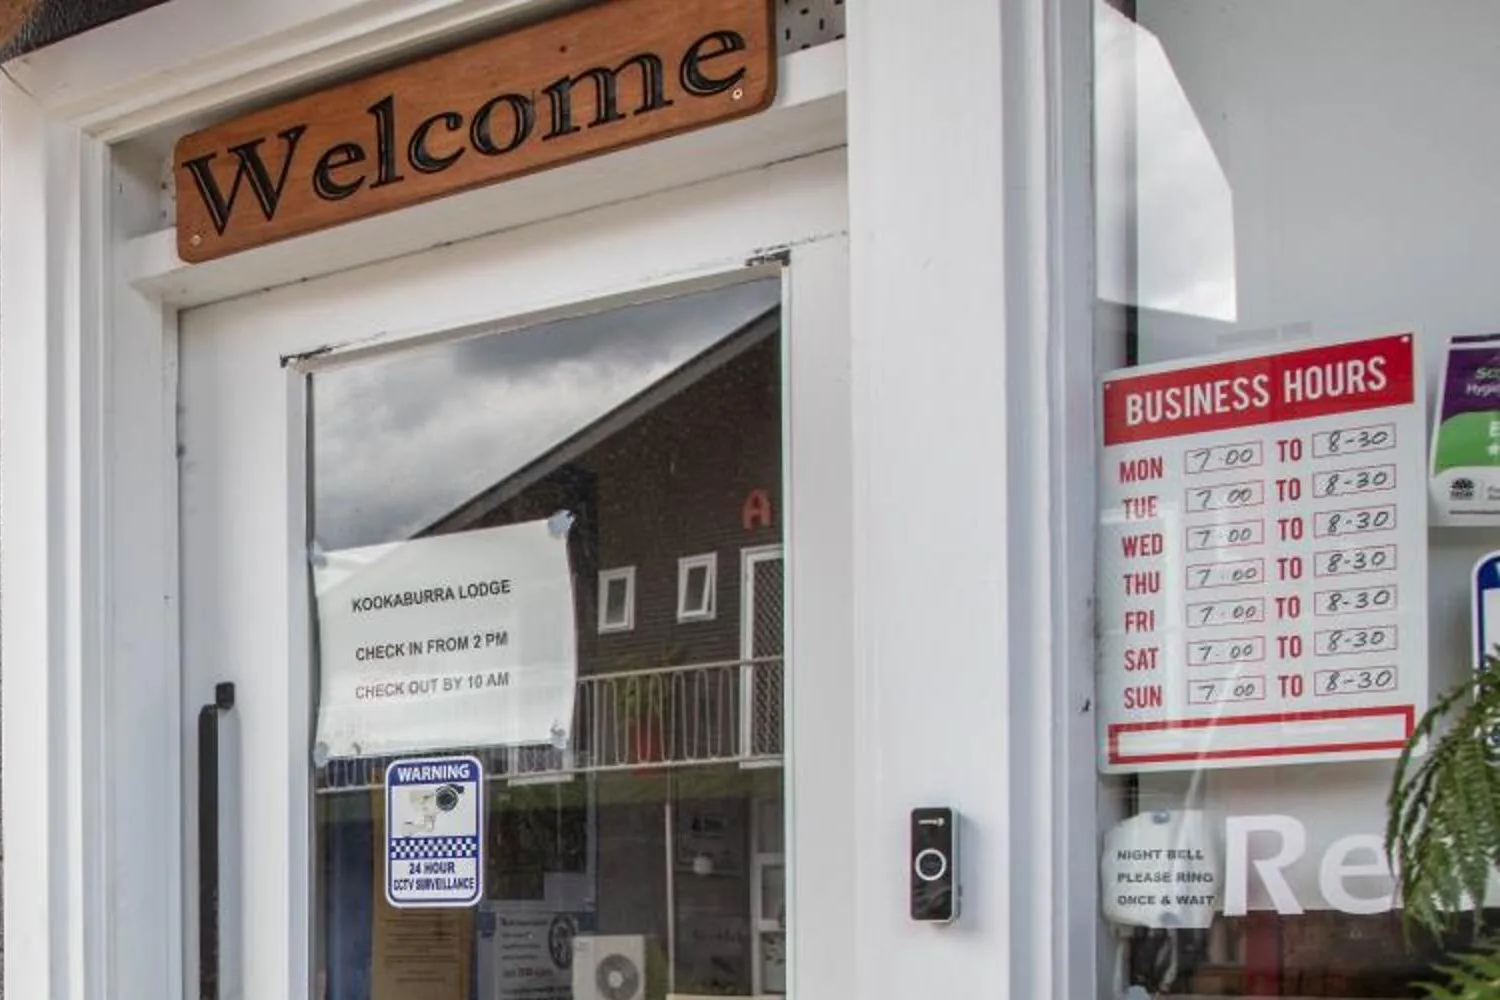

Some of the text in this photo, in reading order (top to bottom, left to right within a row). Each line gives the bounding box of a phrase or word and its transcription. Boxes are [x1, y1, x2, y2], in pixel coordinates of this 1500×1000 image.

[184, 28, 747, 237] Welcome
[1126, 355, 1388, 426] BUSINESS HOURS
[1119, 457, 1163, 483] MON
[1276, 438, 1302, 463] TO
[1122, 496, 1159, 520] TUE
[1275, 478, 1301, 502] TO
[1121, 533, 1163, 558] WED
[1276, 517, 1303, 542] TO
[1123, 572, 1161, 596] THU
[1276, 557, 1302, 581] TO
[352, 579, 512, 612] KOOKABURRA LODGE
[1124, 610, 1155, 634] FRI
[1275, 596, 1301, 619] TO
[355, 631, 509, 661] CHECK IN FROM 2 PM
[1123, 647, 1160, 671] SAT
[1276, 635, 1302, 659] TO
[355, 671, 510, 699] CHECK OUT BY 10 AM
[1123, 686, 1163, 709] SUN
[1277, 675, 1304, 698] TO
[397, 763, 471, 782] WARNING
[409, 861, 456, 875] 24 HOUR
[1117, 849, 1204, 861] NIGHT BELL
[394, 877, 475, 892] CCTV SURVEILLANCE
[1117, 872, 1214, 884] PLEASE RING
[1117, 895, 1215, 906] ONCE & WAIT
